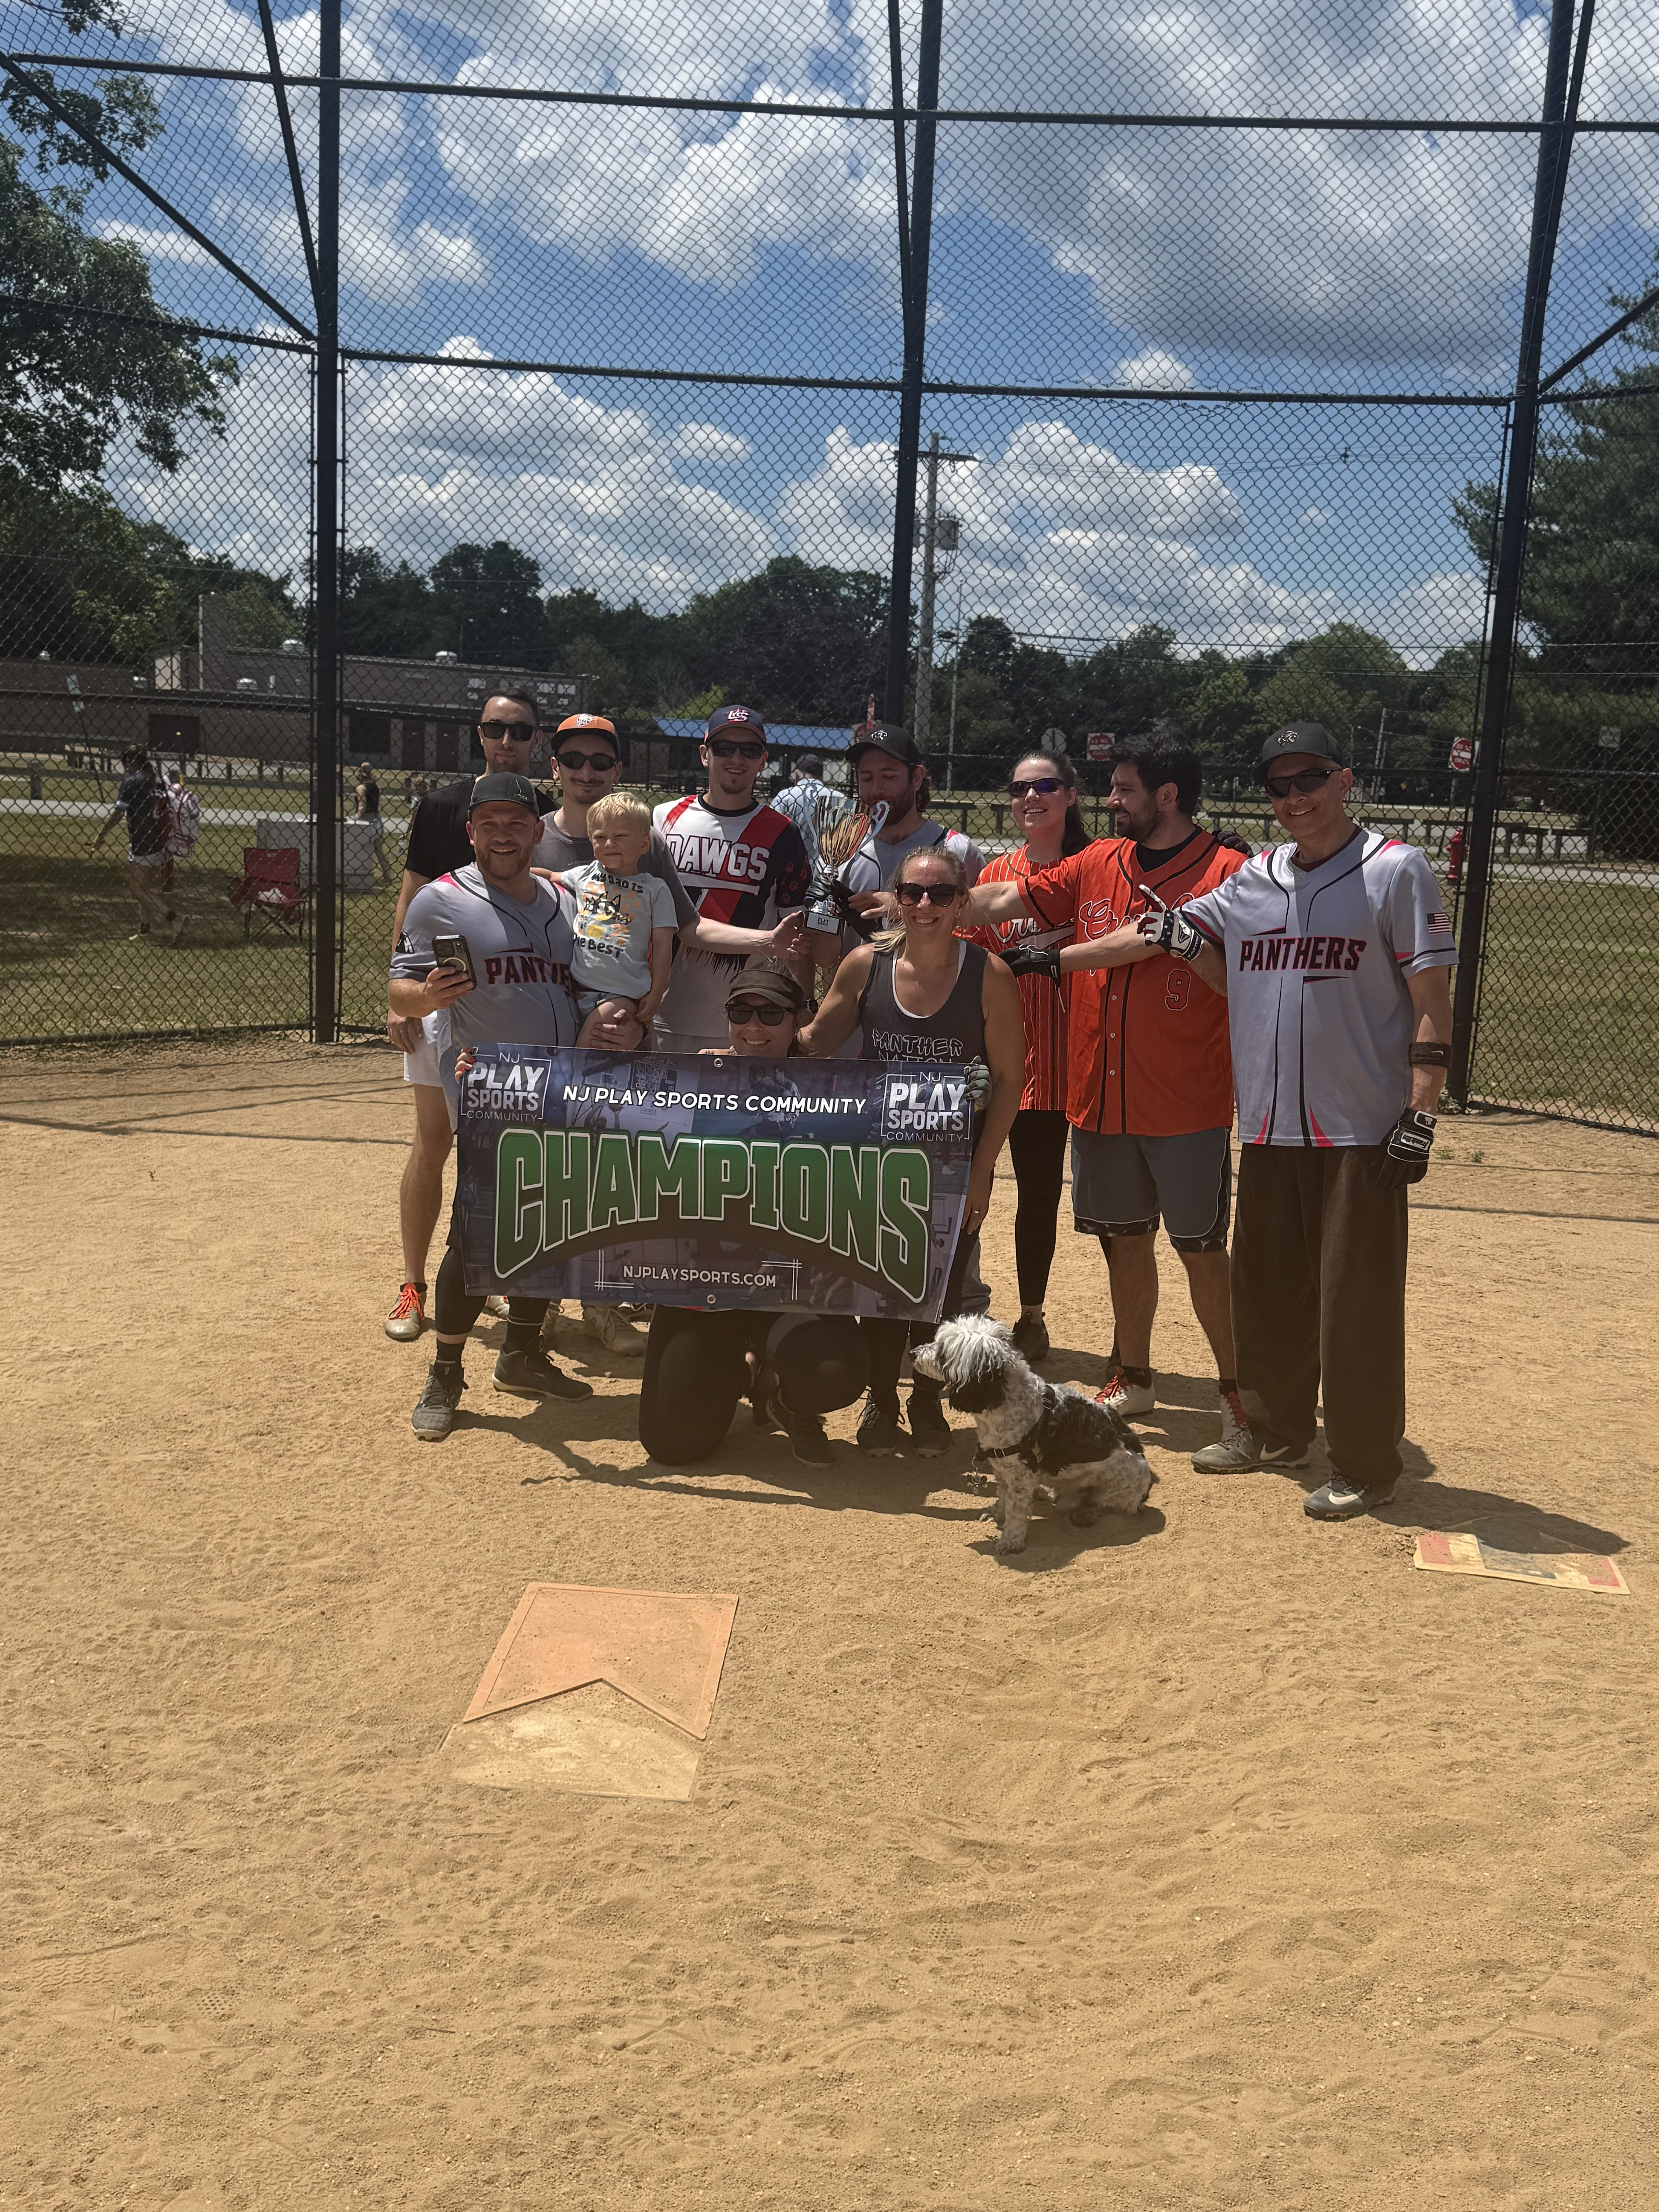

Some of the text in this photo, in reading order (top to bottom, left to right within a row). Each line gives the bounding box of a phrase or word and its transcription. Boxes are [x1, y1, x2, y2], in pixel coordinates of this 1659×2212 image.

[666, 834, 769, 881] DAWGS
[632, 883, 643, 893] IS
[1239, 936, 1367, 972] PANTHERS
[1165, 969, 1192, 1011] 9
[872, 1028, 963, 1056] PANTHER
[499, 1052, 520, 1063] NJ
[468, 1062, 544, 1091] PLAY
[919, 1072, 941, 1082] NJ
[467, 1089, 539, 1111] SPORTS
[563, 1085, 590, 1101] NJ
[595, 1087, 648, 1105] PLAY
[654, 1091, 738, 1111] SPORTS
[745, 1095, 867, 1114] COMMUNITY
[889, 1083, 967, 1110] PLAY
[467, 1110, 537, 1121] COMMUNITY
[887, 1109, 964, 1131] SPORTS
[886, 1132, 963, 1142] COMMUNITY
[494, 1128, 930, 1303] CHAMPIONS
[623, 1266, 776, 1287] NJPLAYSPORTS.COM
